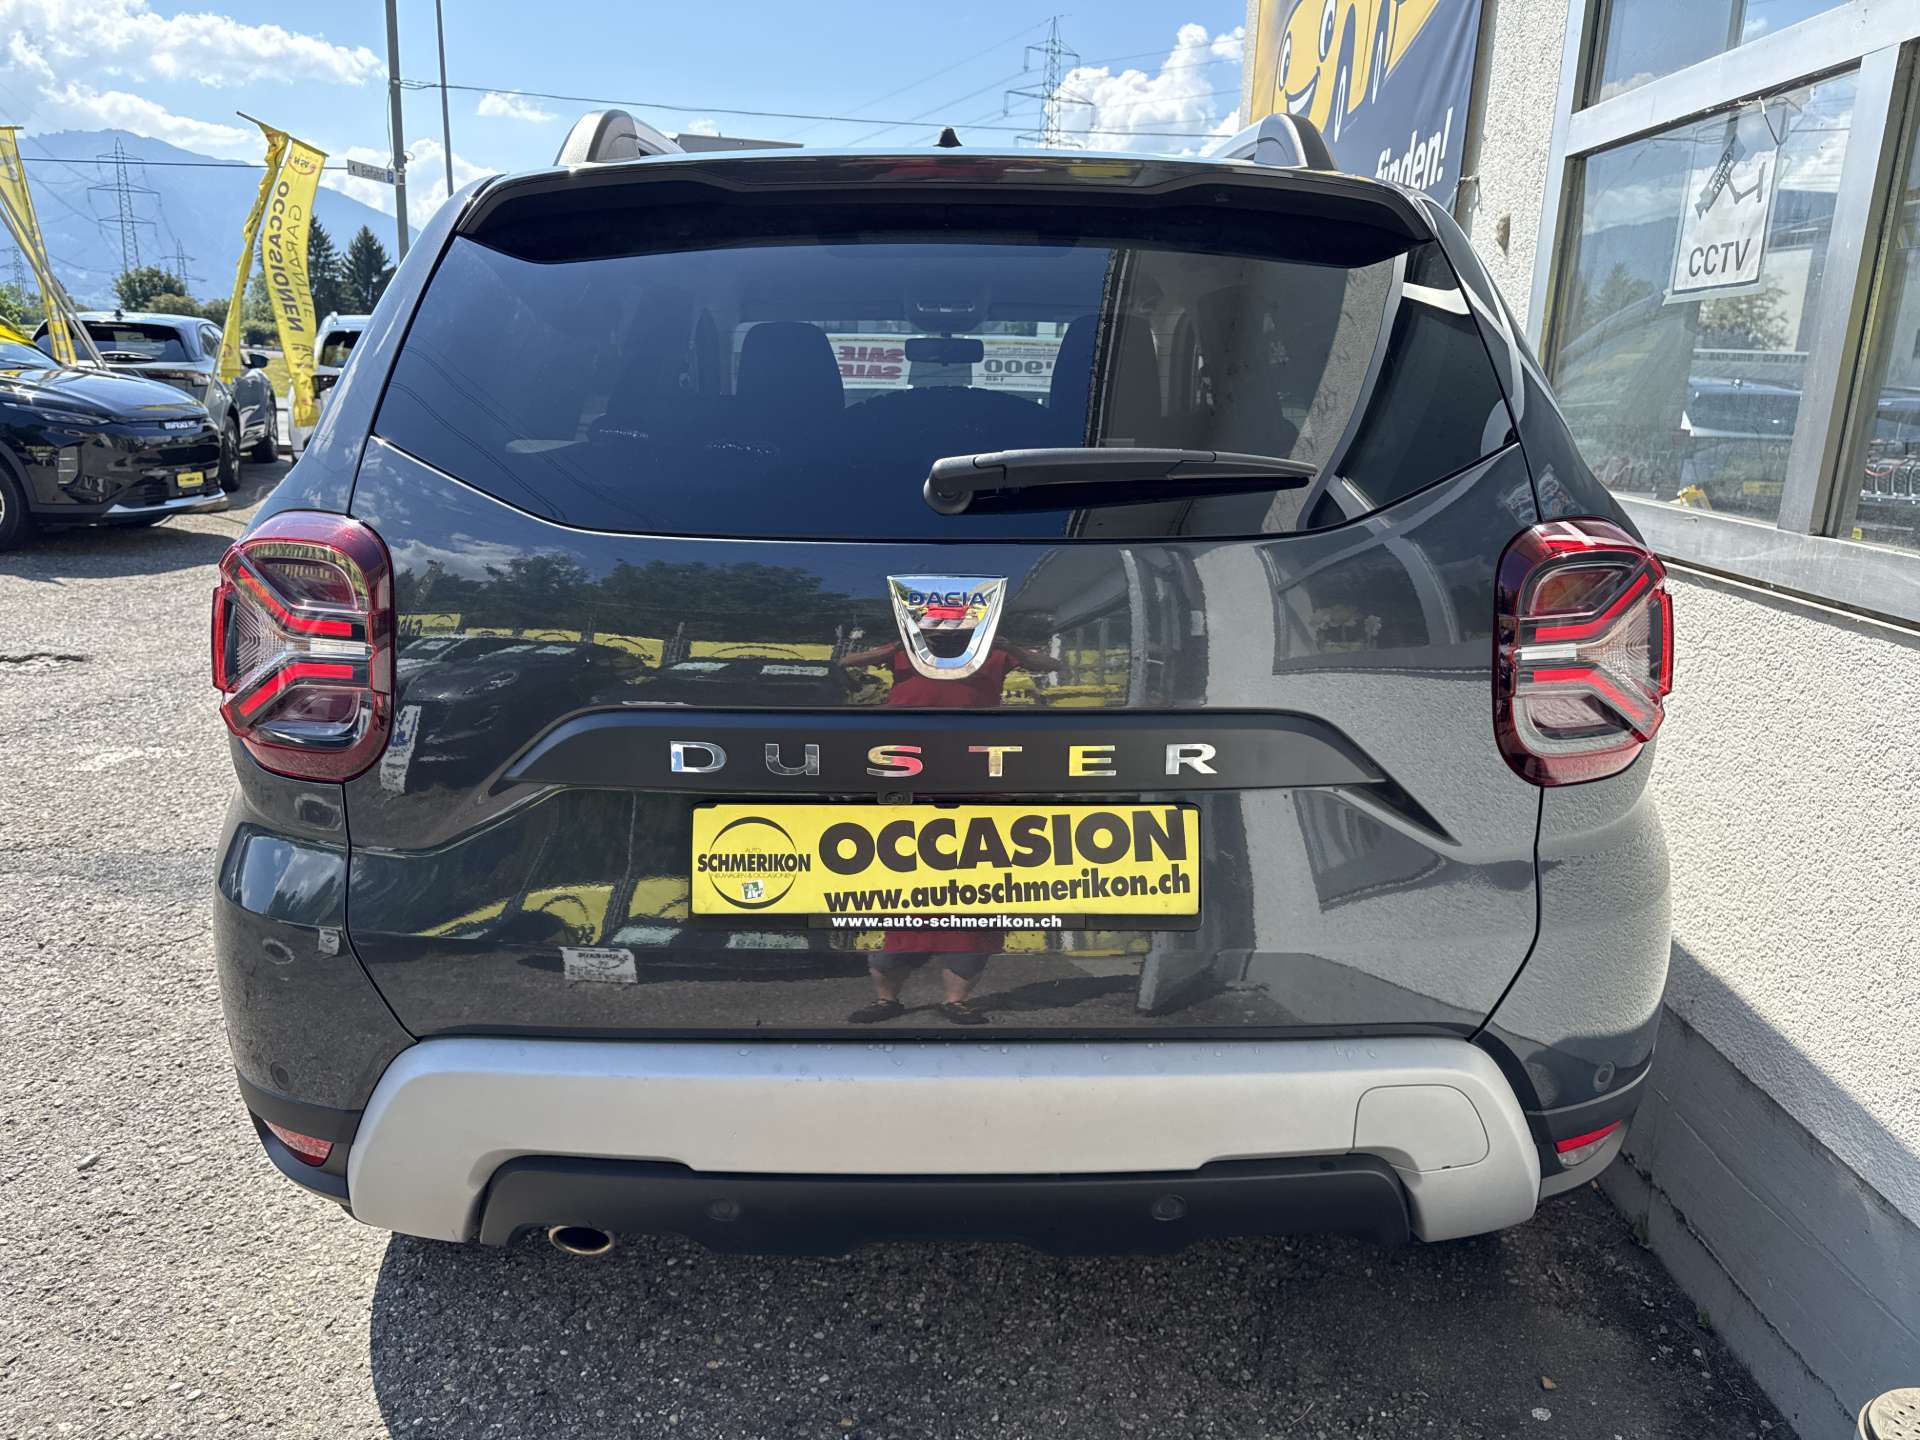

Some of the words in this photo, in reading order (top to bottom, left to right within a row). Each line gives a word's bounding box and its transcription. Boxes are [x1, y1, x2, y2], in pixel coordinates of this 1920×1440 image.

[1376, 107, 1453, 190] finden!
[1688, 238, 1751, 277] CCTV
[908, 592, 987, 607] DACIA
[669, 740, 1219, 777] DUSTER
[819, 810, 1188, 875] OCCASION
[697, 854, 811, 872] SCHMERIKON
[823, 864, 1191, 913] www.autoschmerikon.ch
[832, 915, 1062, 928] www.auto-schmerikon.ch
